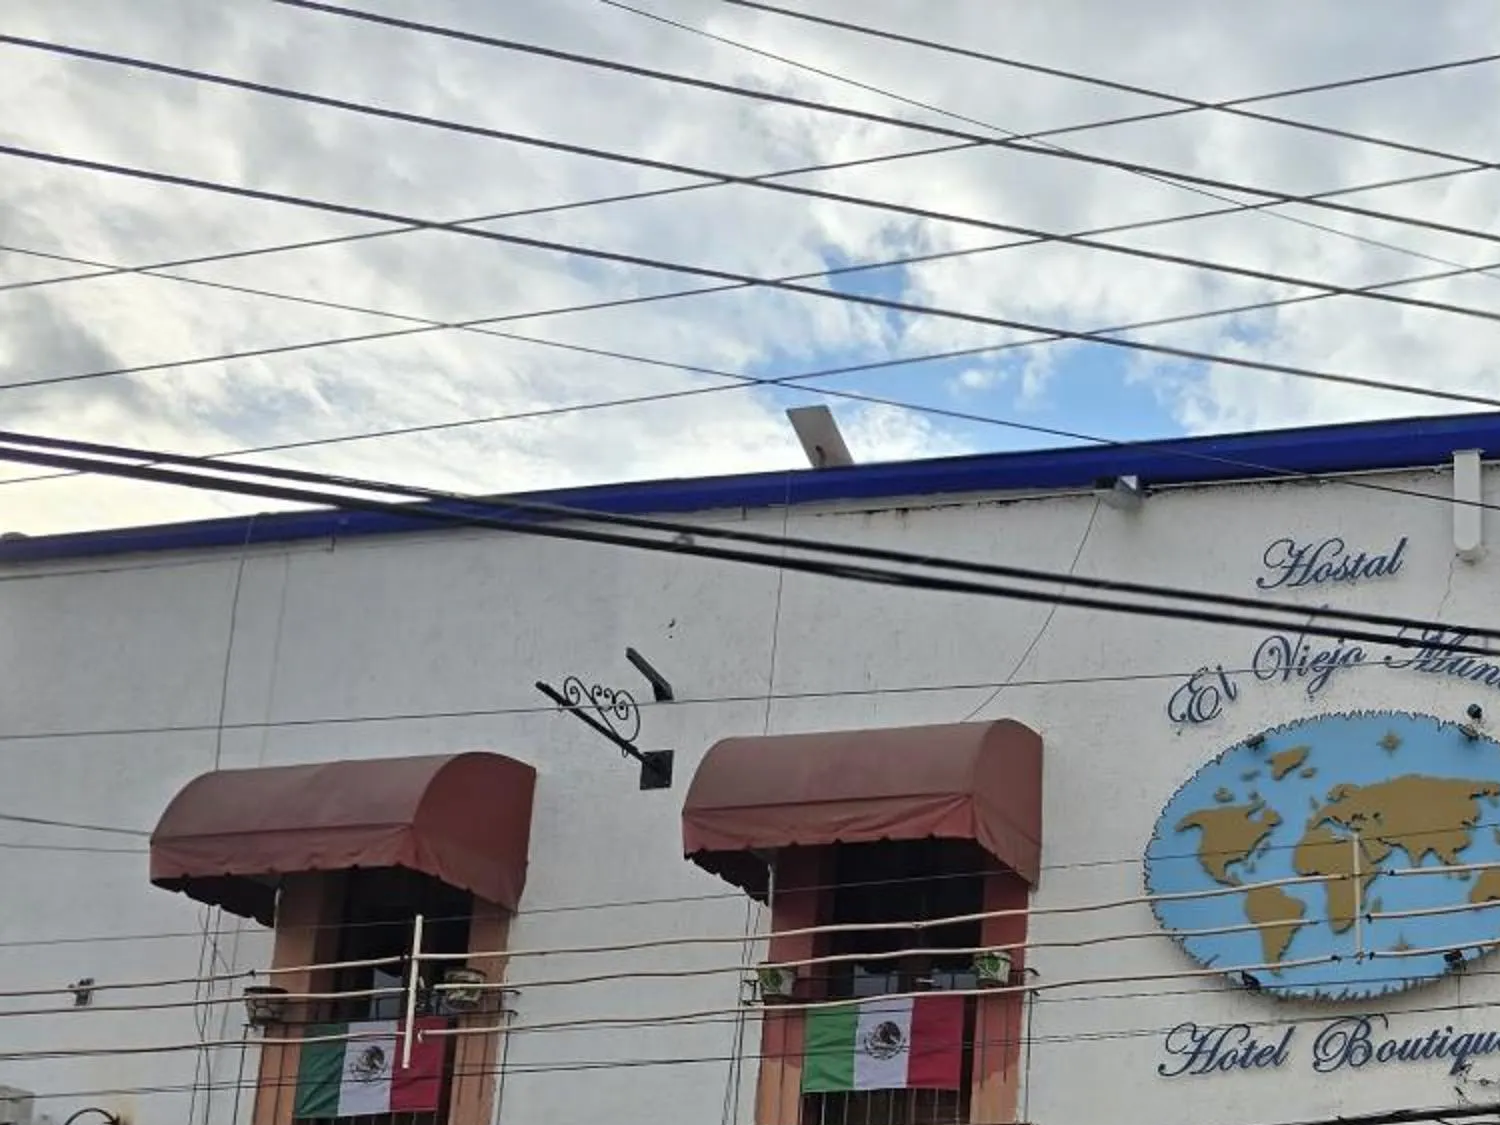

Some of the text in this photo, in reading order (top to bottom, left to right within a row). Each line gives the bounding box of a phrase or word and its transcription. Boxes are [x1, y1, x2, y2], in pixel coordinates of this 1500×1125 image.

[1256, 536, 1409, 590] Hostal
[1167, 663, 1238, 724] El
[1252, 604, 1367, 694] Viejo
[1157, 1021, 1296, 1077] Hotel
